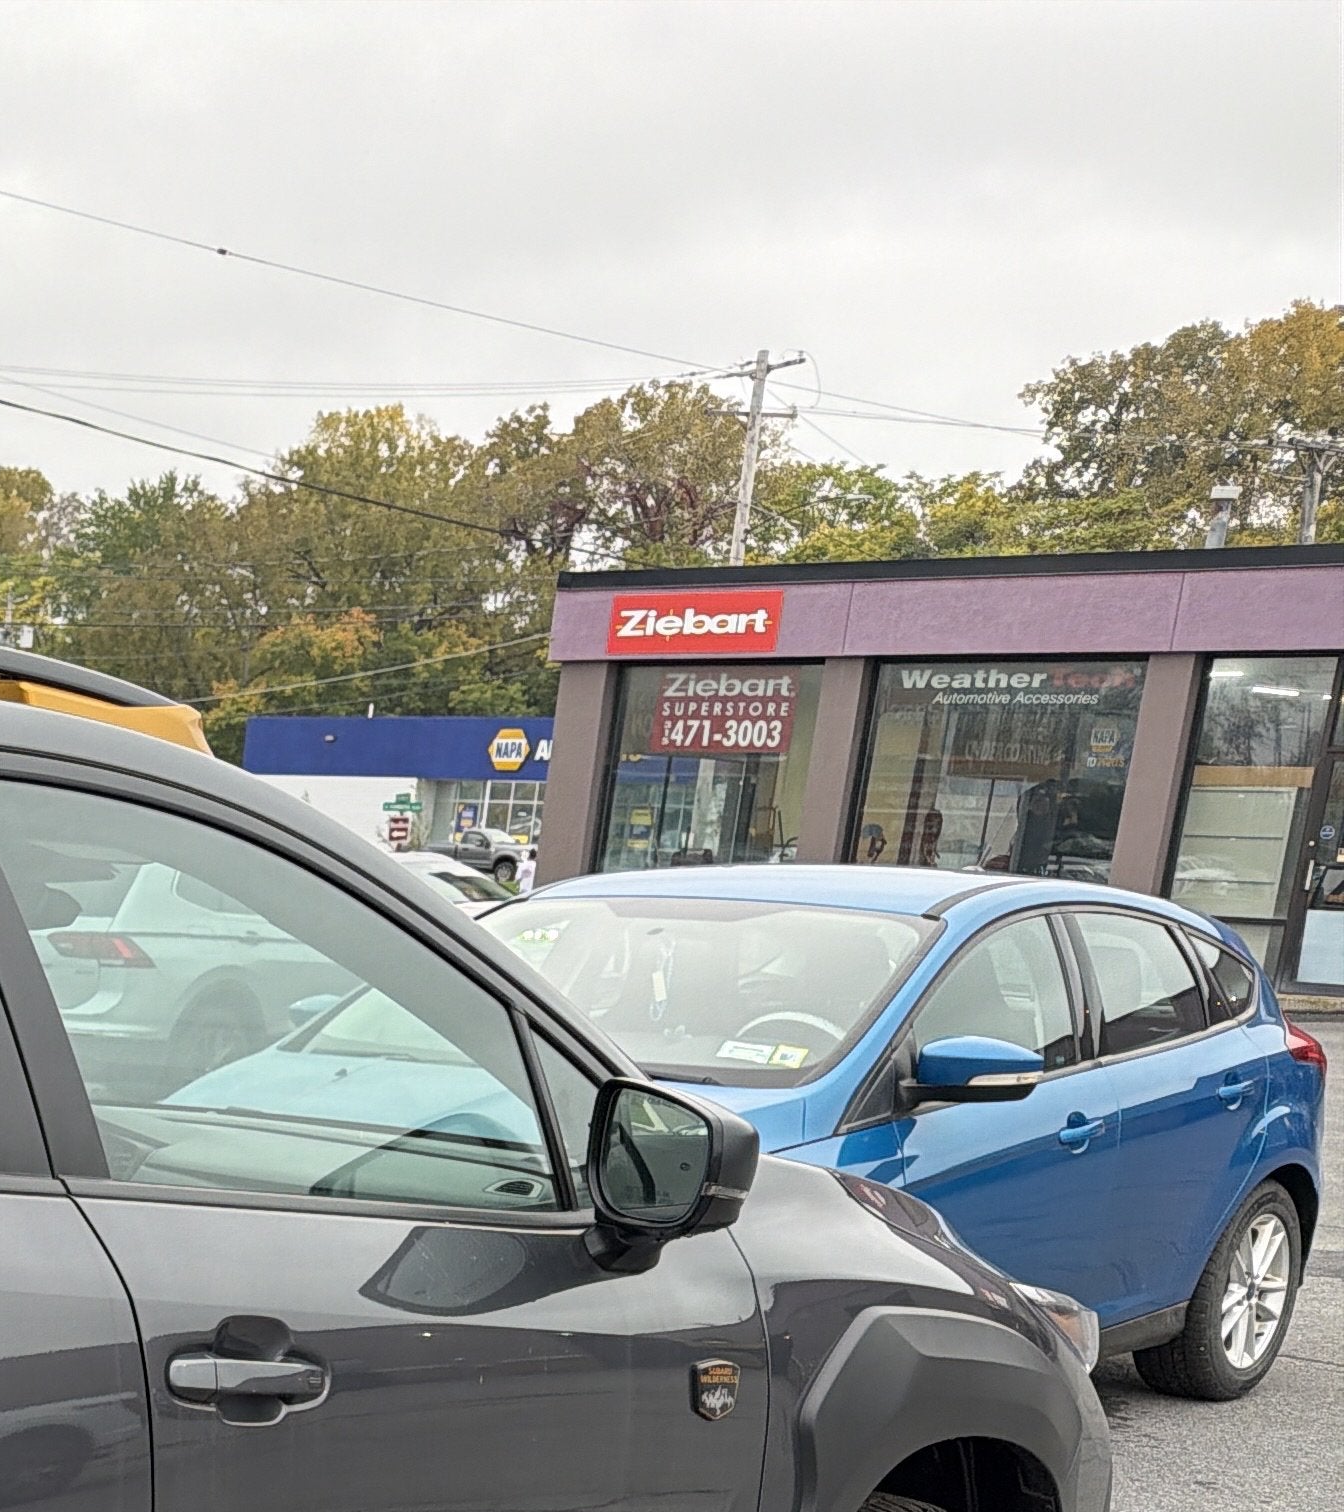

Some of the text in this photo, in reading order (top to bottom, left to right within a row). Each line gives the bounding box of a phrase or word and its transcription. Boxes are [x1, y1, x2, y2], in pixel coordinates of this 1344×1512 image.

[617, 608, 769, 637] Ziebart
[663, 673, 792, 697] Ziebart
[932, 690, 1100, 705] Automotive Accessories
[662, 701, 790, 717] SUPERSTORE
[670, 719, 783, 748] 471-3003
[495, 741, 523, 759] NAPA
[700, 1375, 738, 1384] WILDERNESS
